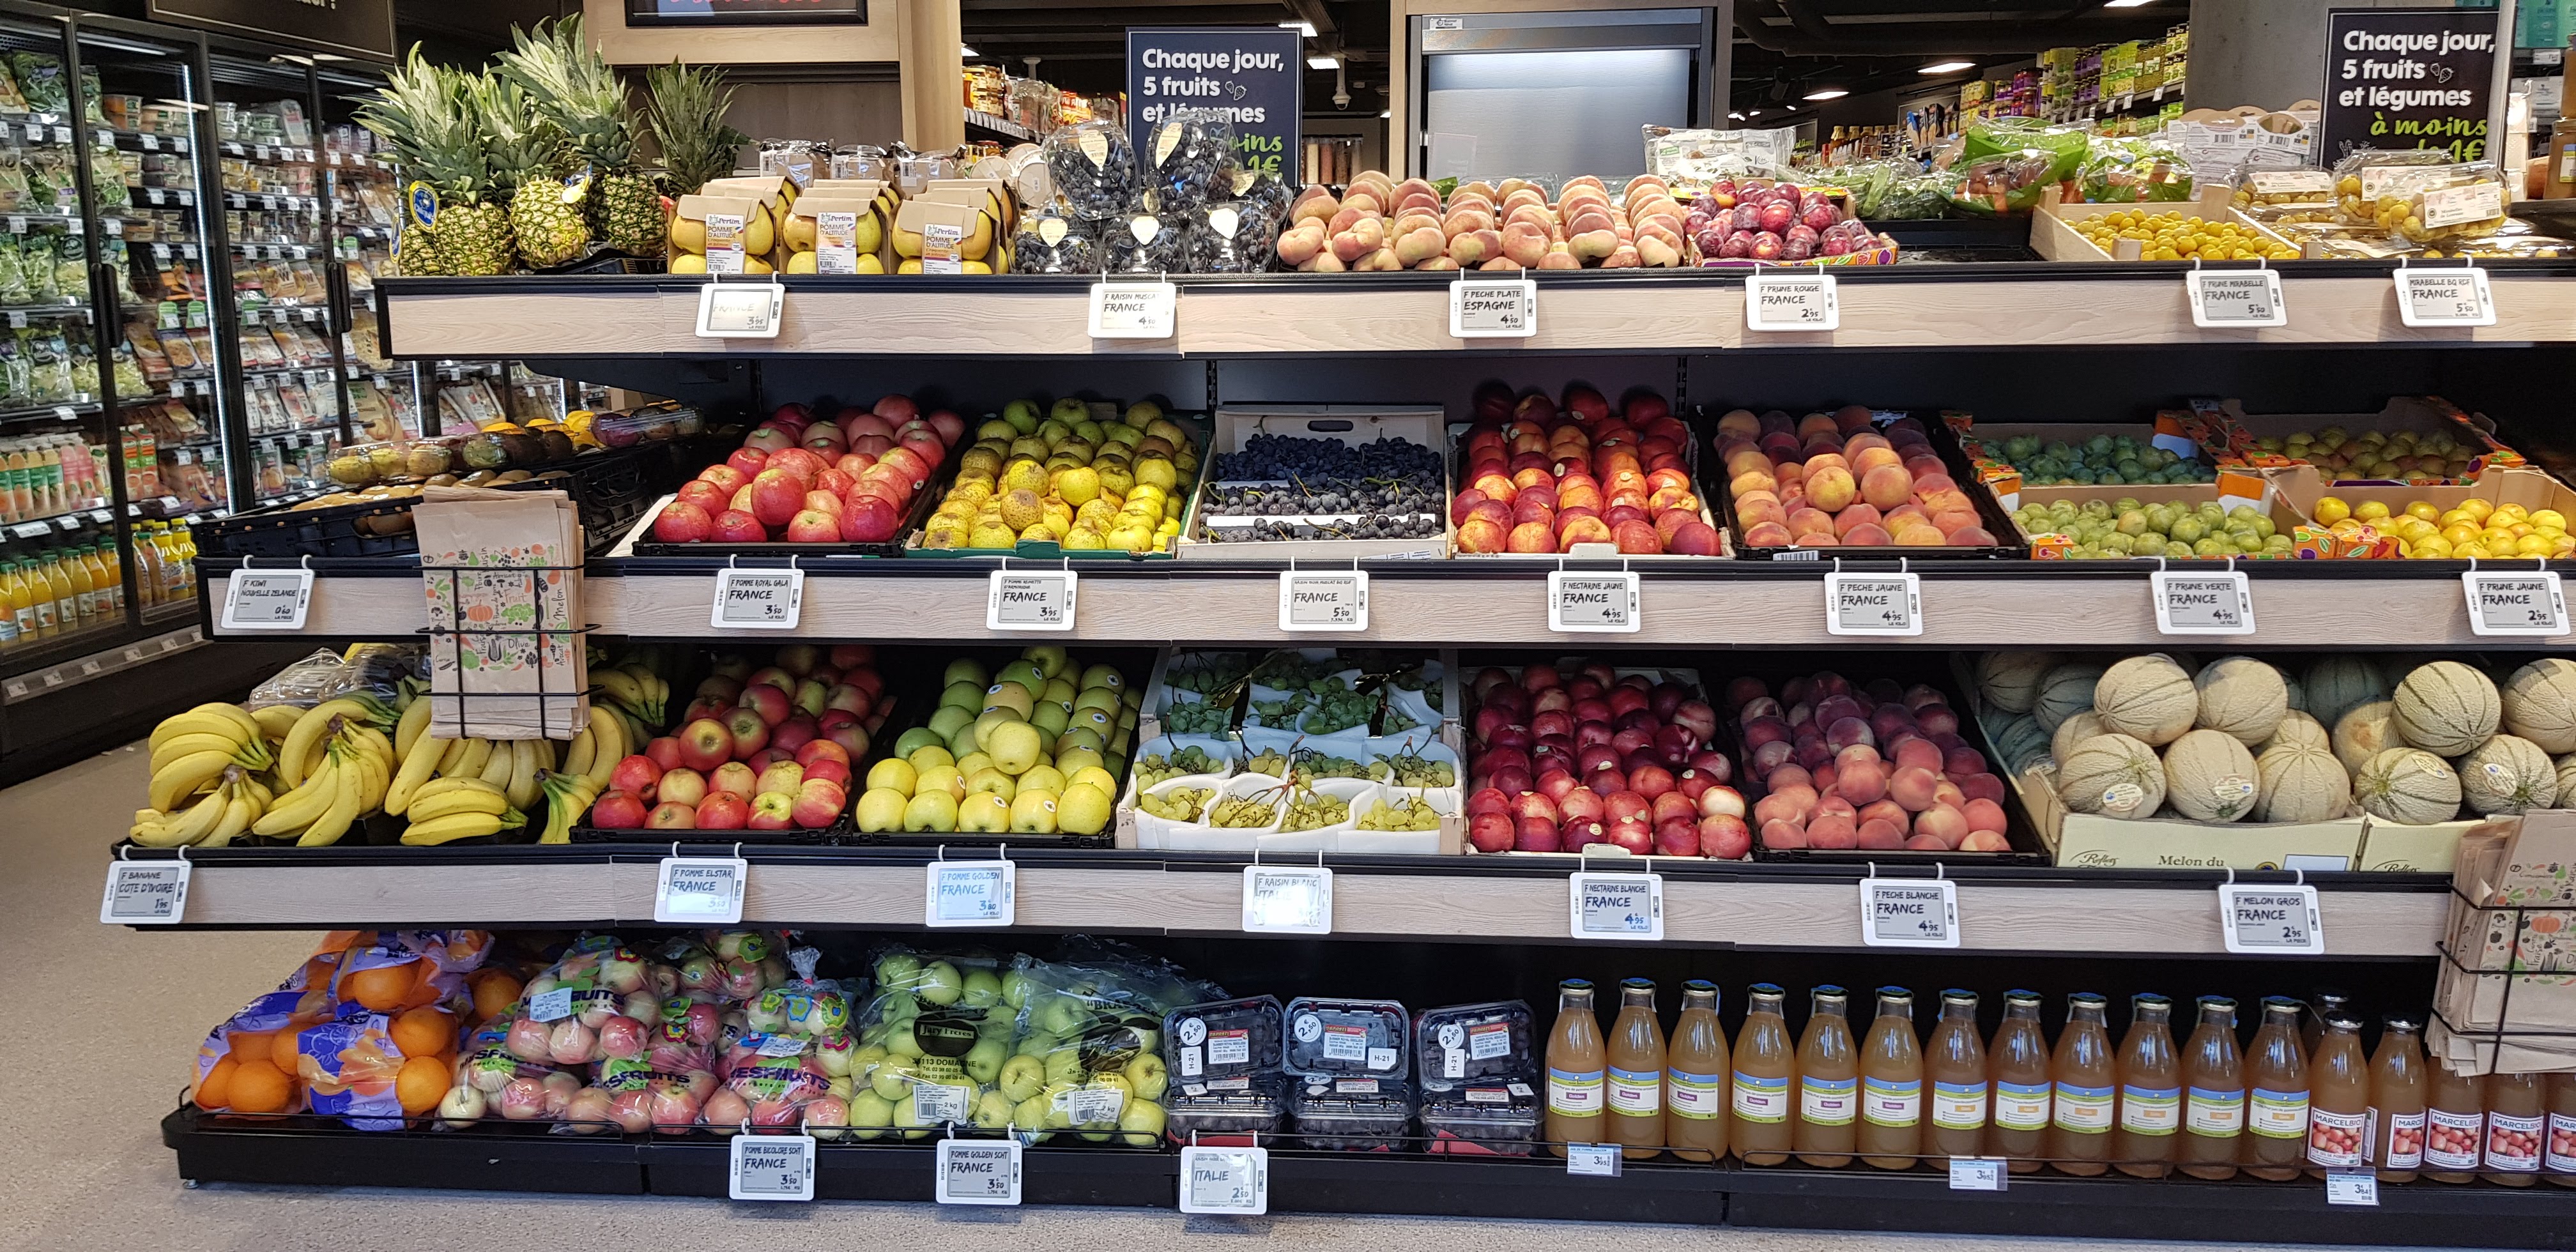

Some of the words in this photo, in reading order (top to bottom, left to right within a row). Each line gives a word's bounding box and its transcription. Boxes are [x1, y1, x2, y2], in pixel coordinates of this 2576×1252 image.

[2343, 31, 2438, 55] Chaque
[2439, 31, 2495, 56] jour,
[1142, 49, 1230, 73] Chaque
[1232, 49, 1284, 74] jour,
[2341, 59, 2358, 79] 5
[2363, 59, 2426, 79] fruits
[1143, 76, 1156, 96] 5
[1162, 76, 1220, 96] fruits
[2338, 87, 2365, 106] et
[2368, 86, 2472, 111] légumes
[1142, 103, 1165, 123] et
[2370, 111, 2388, 135] à
[2393, 117, 2488, 137] moins
[2204, 291, 2251, 300] FRANCE
[2412, 289, 2458, 299] FRANCE
[1761, 296, 1805, 304] FRANCE
[1104, 303, 1145, 312] FRANCE
[1464, 302, 1515, 310] ESPAGNE
[504, 588, 528, 603] Fruit
[729, 590, 773, 600] FRANCE
[1003, 593, 1046, 602] FRANCE
[1294, 593, 1338, 603] FRANCE
[1563, 593, 1609, 603] FRANCE
[2170, 595, 2217, 604] FRANCE
[553, 588, 565, 621] Melon
[1841, 596, 1888, 606] FRANCE
[2482, 595, 2531, 606] FRANCE
[508, 637, 530, 649] Olive
[2158, 855, 2202, 866] Melon
[2206, 857, 2224, 866] du
[119, 883, 139, 893] COTE
[141, 883, 174, 893] D'IVOIRE
[673, 882, 717, 891] FRANCE
[942, 884, 985, 896] FRANCE
[1585, 897, 1631, 908] FRANCE
[2277, 897, 2300, 905] GROS
[1876, 903, 1924, 914] FRANCE
[2237, 910, 2286, 920] FRANCE
[2315, 1114, 2361, 1126] MARCELBIO
[744, 1159, 787, 1168] FRANCE
[951, 1163, 993, 1173] FRANCE
[1195, 1171, 1229, 1181] ITALIE
